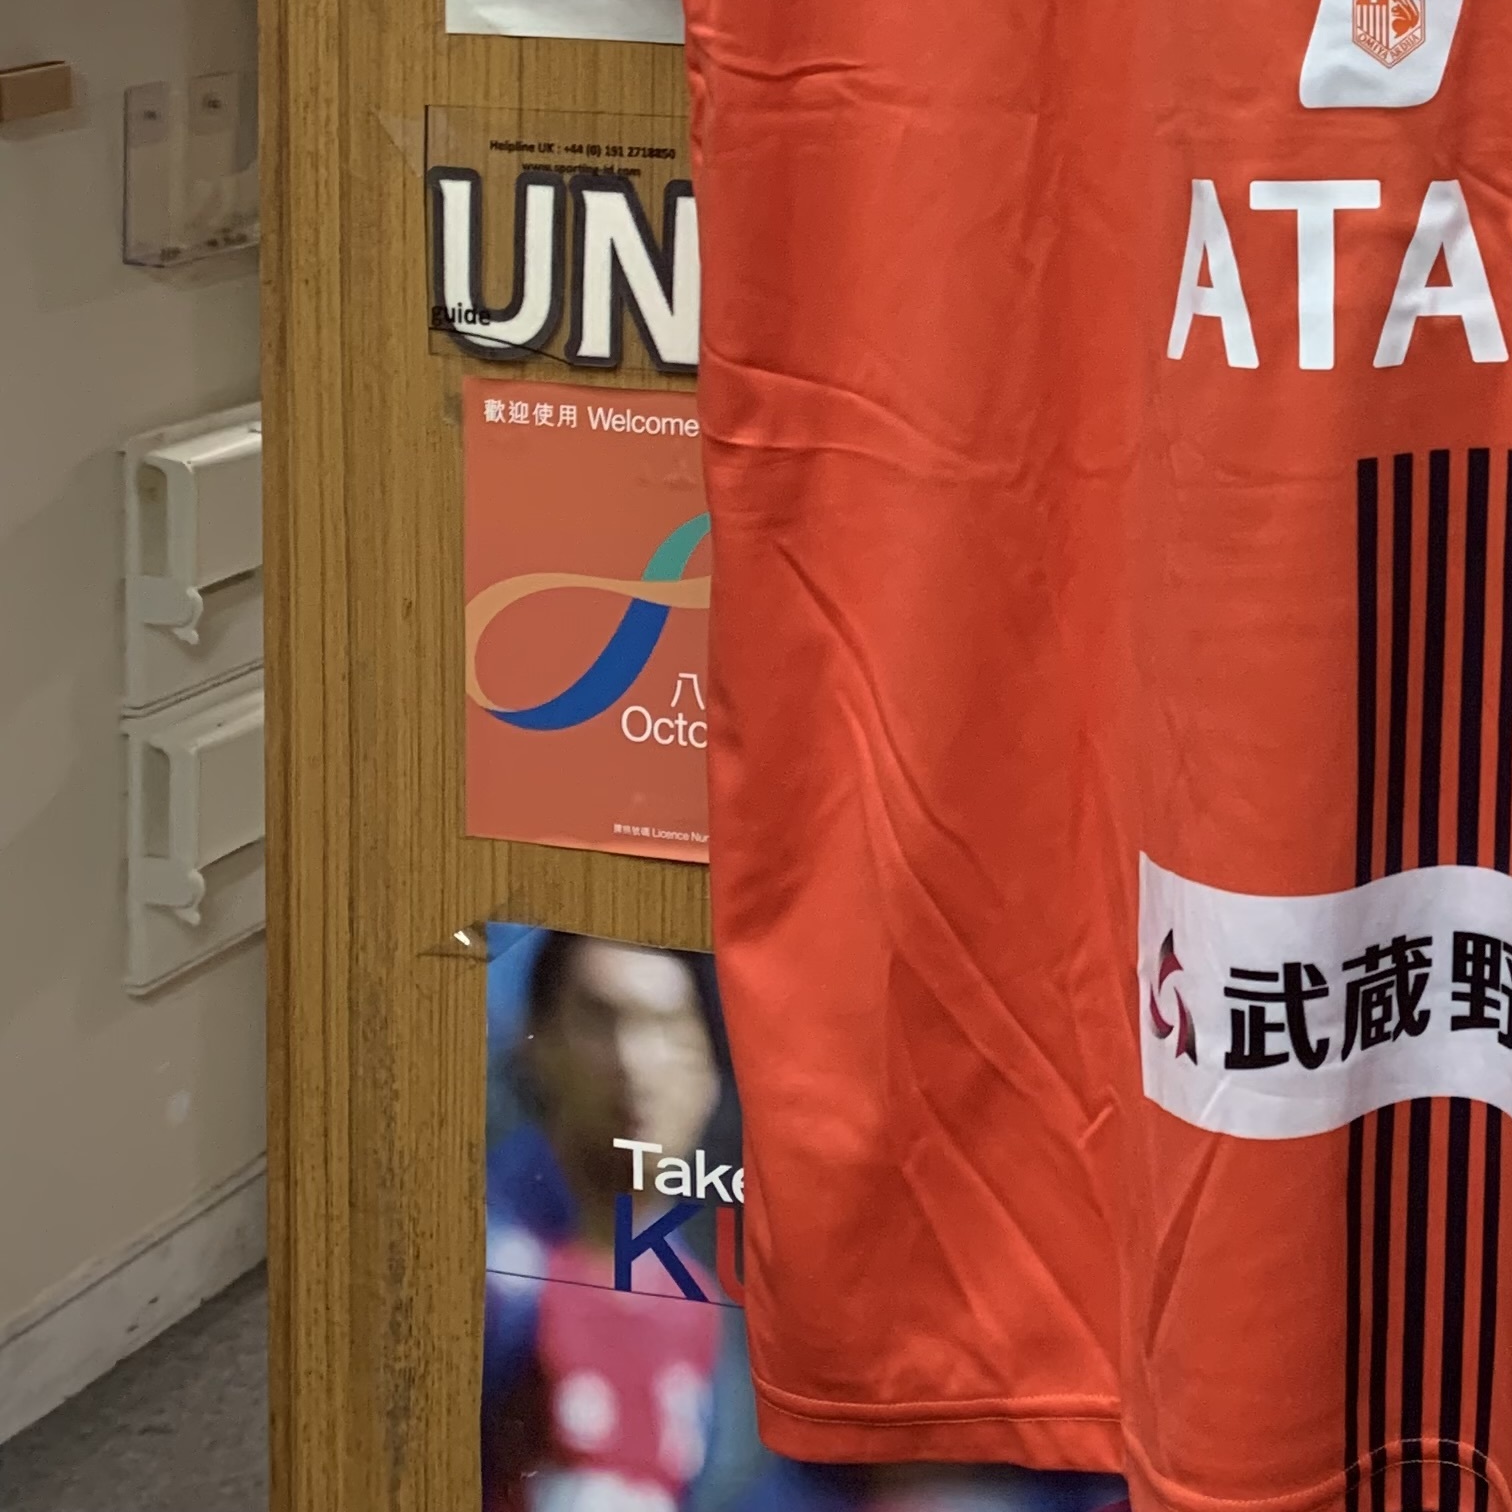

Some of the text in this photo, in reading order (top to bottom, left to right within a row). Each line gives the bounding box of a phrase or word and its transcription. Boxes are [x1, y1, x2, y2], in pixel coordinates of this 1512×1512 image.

[1358, 33, 1388, 60] OMIYA
[490, 140, 535, 154] Helpline
[430, 170, 698, 370] UN
[431, 302, 491, 326] guide
[483, 398, 699, 437] 歡迎使用 Welcome
[670, 672, 705, 710] 八
[652, 828, 689, 841] Licence
